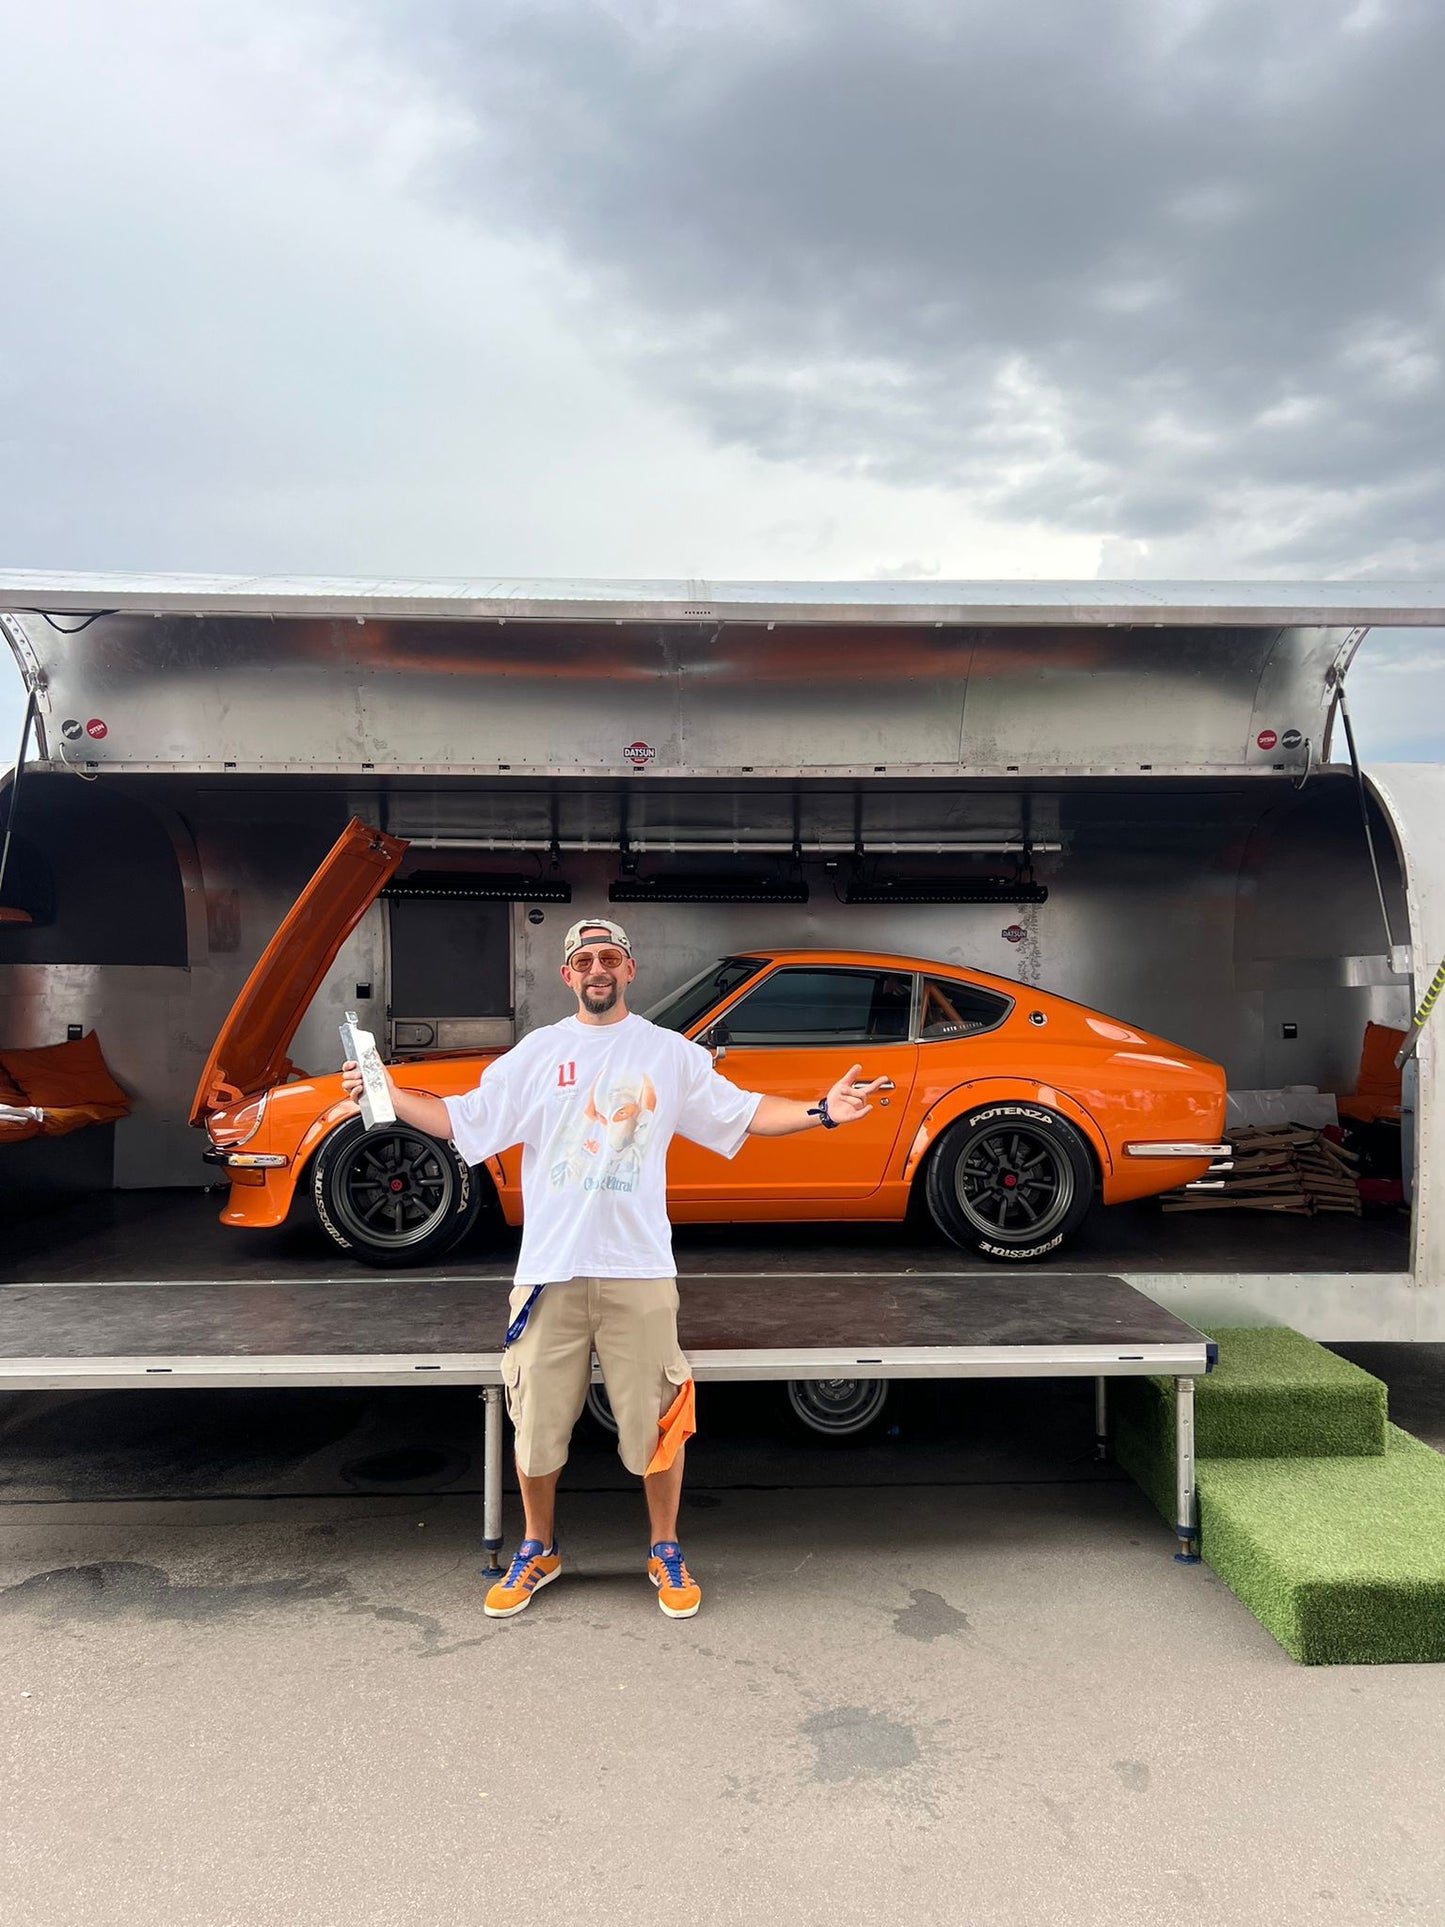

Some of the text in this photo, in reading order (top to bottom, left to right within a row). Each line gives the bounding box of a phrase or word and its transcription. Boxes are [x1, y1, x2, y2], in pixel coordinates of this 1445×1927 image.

[624, 748, 655, 757] DATSUN
[1002, 930, 1026, 938] DATSUN
[969, 1107, 1053, 1128] POTENZA
[447, 1138, 470, 1214] OTENZA
[314, 1166, 353, 1249] BRIDGESTONE
[979, 1232, 1064, 1259] BRIDGESTONE
